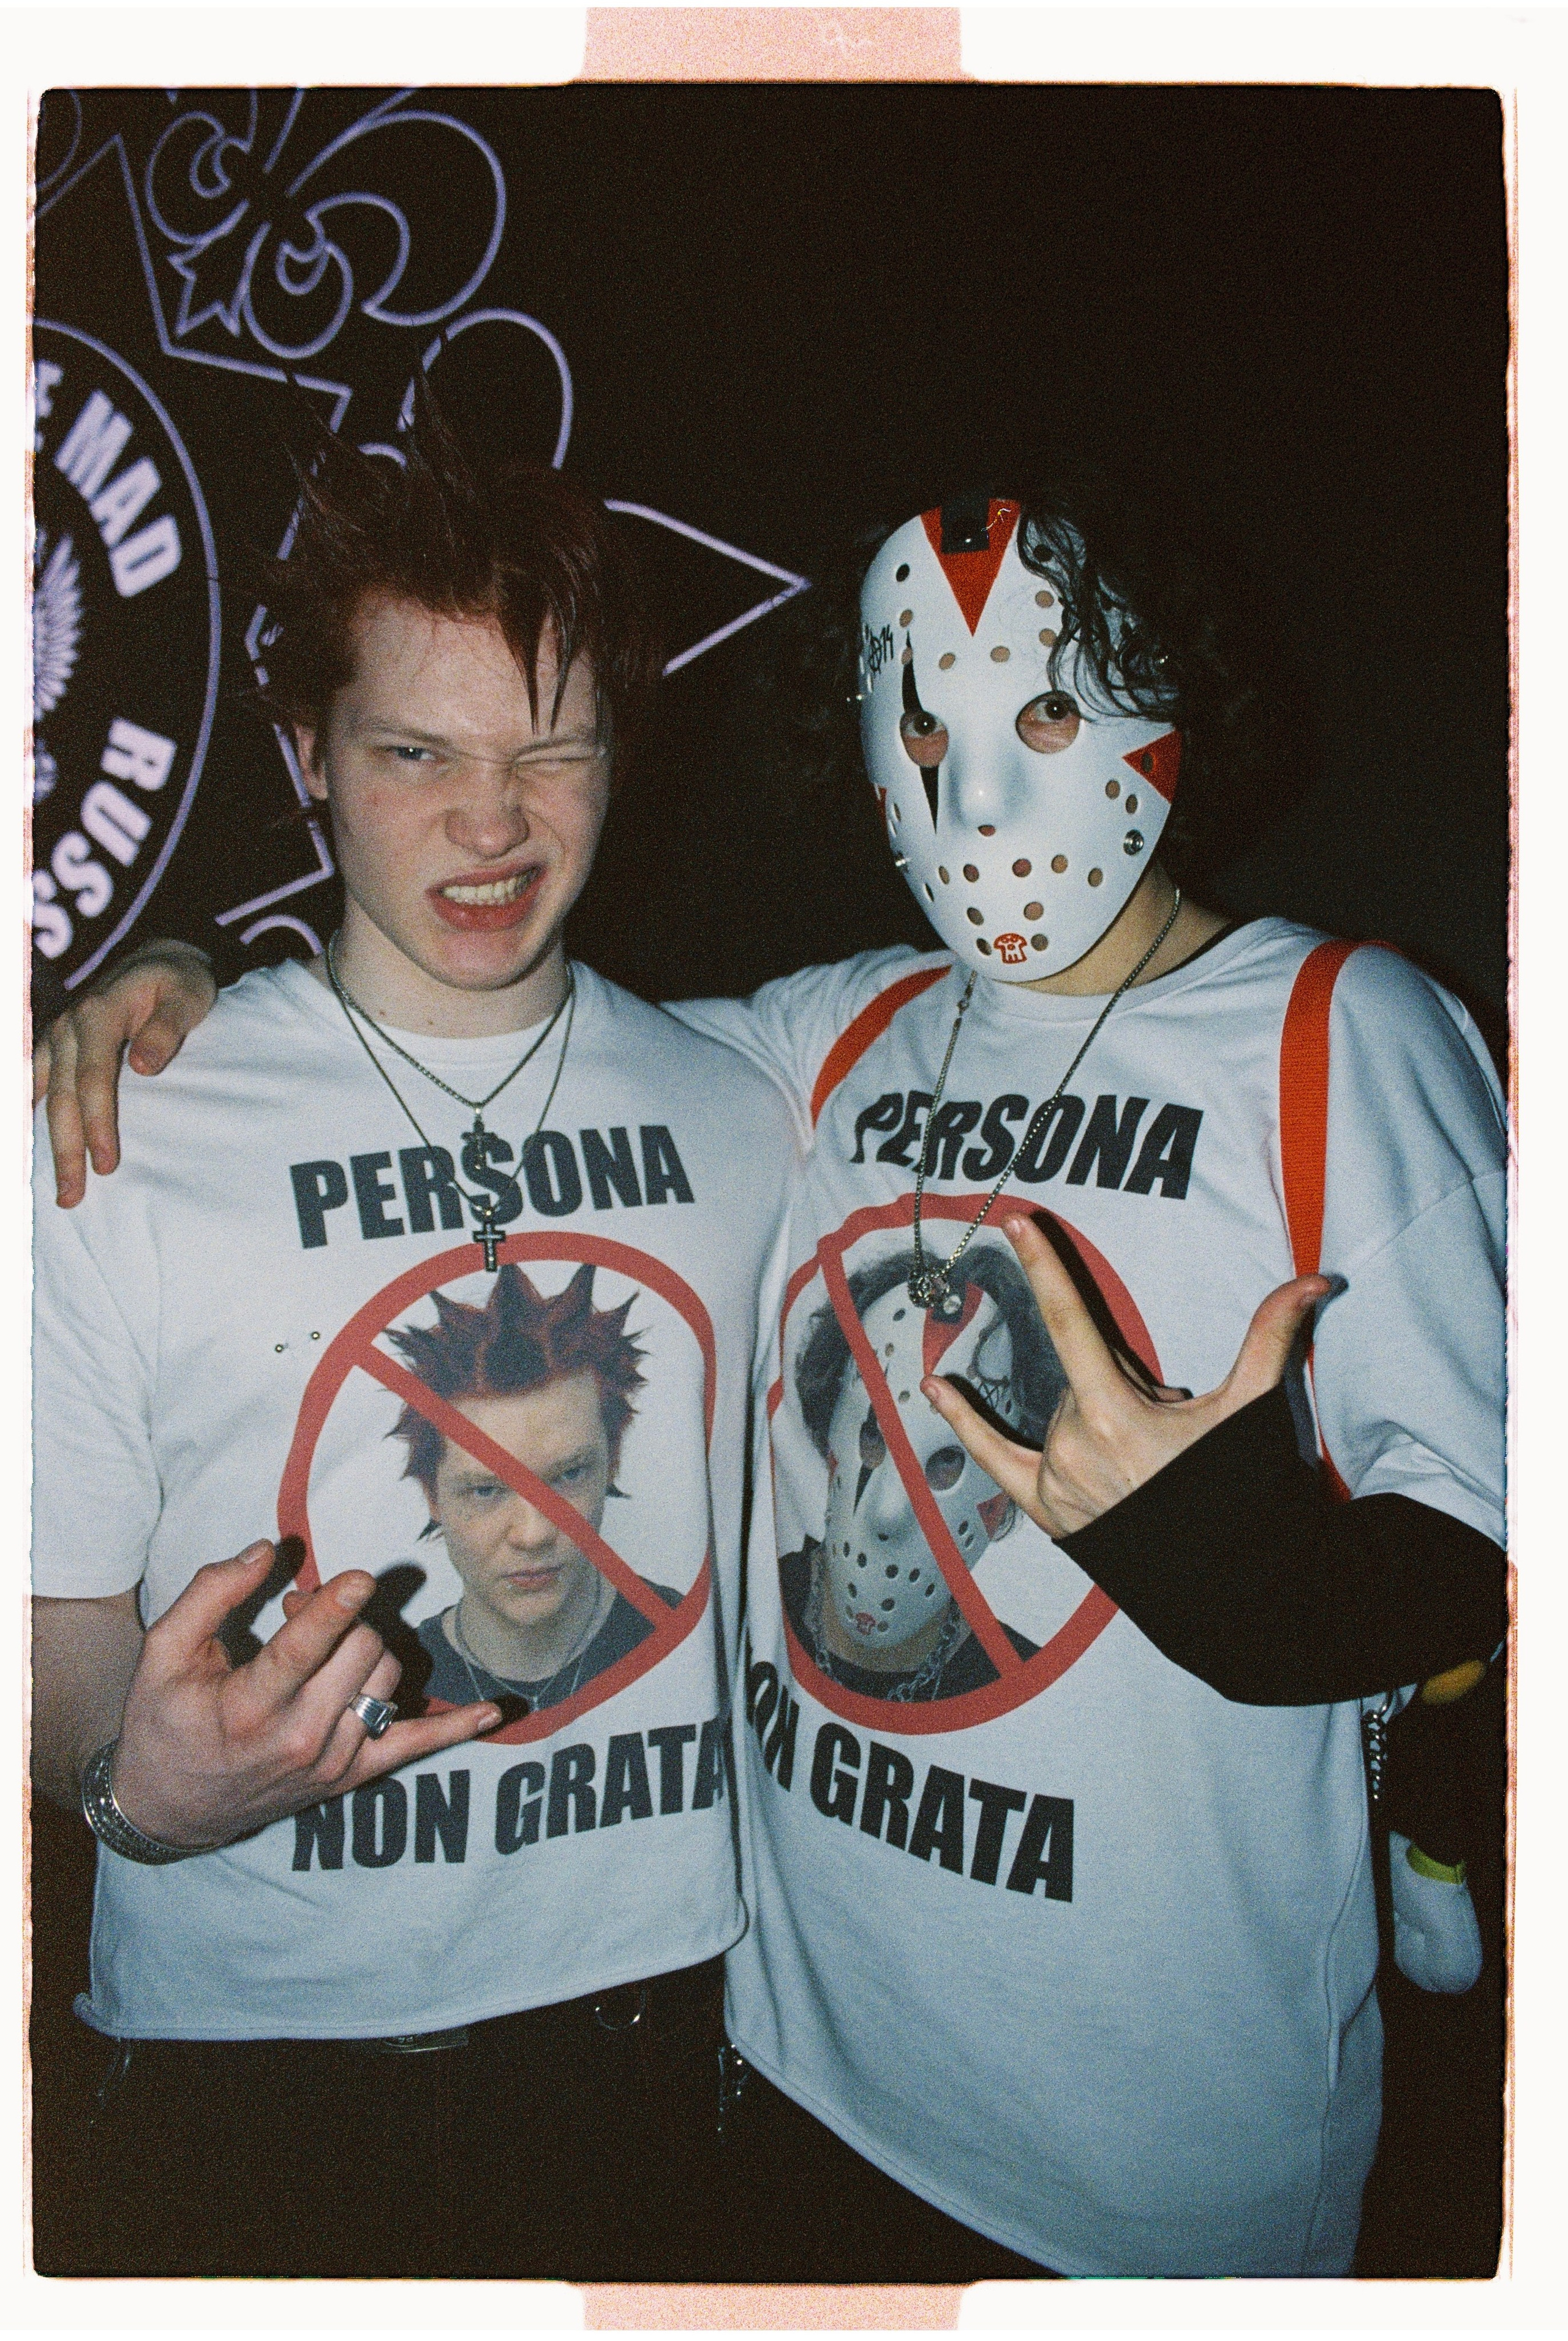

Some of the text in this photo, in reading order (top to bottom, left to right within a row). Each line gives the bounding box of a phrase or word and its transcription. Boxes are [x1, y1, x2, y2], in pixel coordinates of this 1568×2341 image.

[53, 387, 182, 598] MAD
[289, 1124, 696, 1250] PERSONA
[849, 1089, 1204, 1200] PERSONA
[292, 1717, 731, 1872] NON GRATA
[744, 1660, 1074, 1904] ON GRATA
